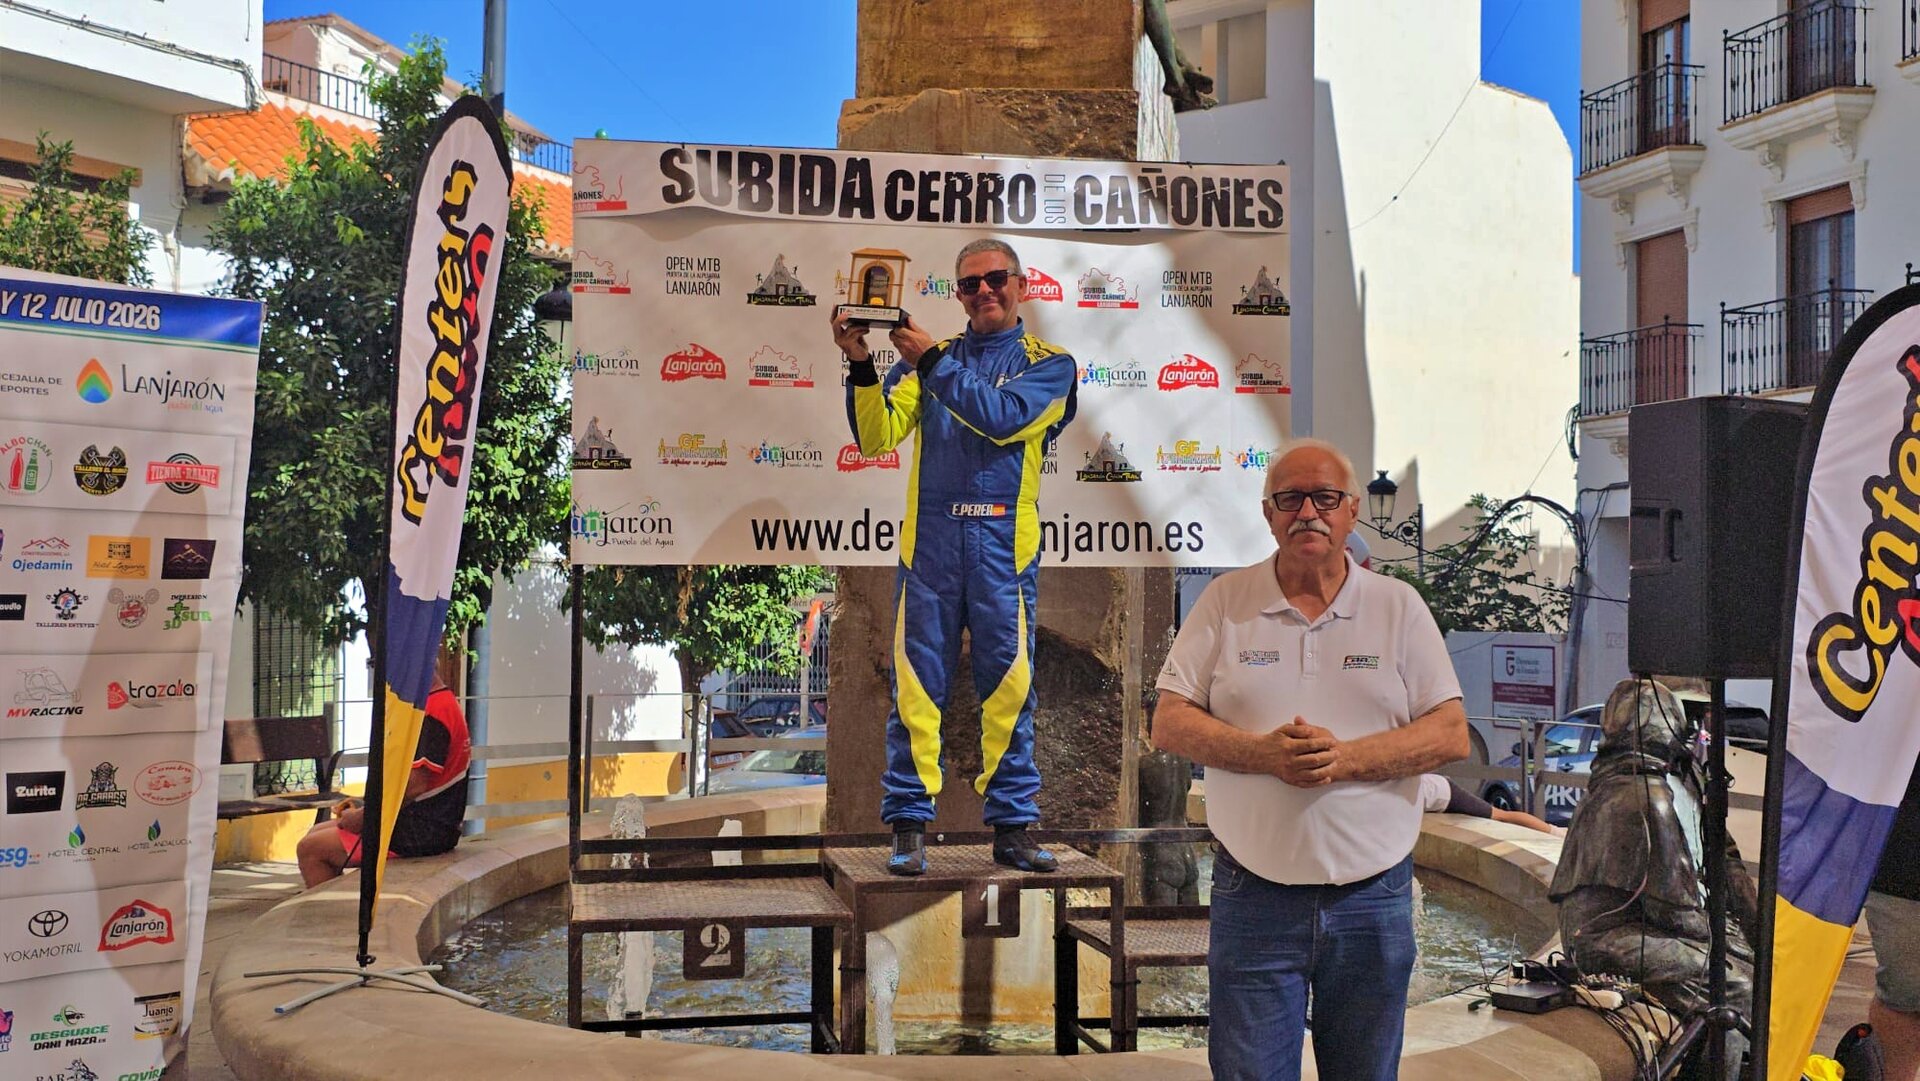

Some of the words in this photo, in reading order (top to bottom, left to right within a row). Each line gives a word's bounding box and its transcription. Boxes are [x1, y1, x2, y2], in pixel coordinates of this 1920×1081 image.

[660, 148, 875, 220] SUBIDA
[884, 169, 1036, 225] CERRO
[1044, 174, 1066, 193] DE
[573, 191, 602, 200] AÑONES
[1073, 167, 1284, 229] CAÑONES
[1044, 199, 1066, 225] LOS
[666, 256, 693, 271] OPEN
[697, 257, 720, 272] MTB
[1162, 270, 1187, 284] OPEN
[1190, 271, 1212, 285] MTB
[666, 278, 720, 296] LANJARÓN
[1161, 290, 1212, 308] LANJARÓN
[1, 290, 17, 315] Y
[21, 293, 47, 318] 12
[50, 296, 106, 325] JULIO
[107, 301, 161, 331] 2026
[665, 357, 722, 375] Lanjarón
[0, 372, 45, 384] CEJALIA
[48, 377, 63, 385] DE
[1162, 367, 1215, 384] Lanjarón
[0, 384, 49, 396] EPORTES
[952, 503, 994, 516] E.PEREA
[181, 611, 212, 622] SUR
[15, 784, 57, 798] Zurita
[48, 850, 78, 859] HOTEL
[81, 846, 121, 856] CENTRAL
[128, 842, 150, 851] HOTEL
[979, 884, 1001, 927] 1
[110, 918, 164, 938] Lanjarón
[4, 942, 83, 963] YOKAMOTRIL
[700, 923, 731, 967] 2
[142, 1003, 174, 1017] Juanjo
[30, 1025, 110, 1041] DESGUACE
[33, 1040, 62, 1051] DANI
[65, 1036, 97, 1048] MAZA
